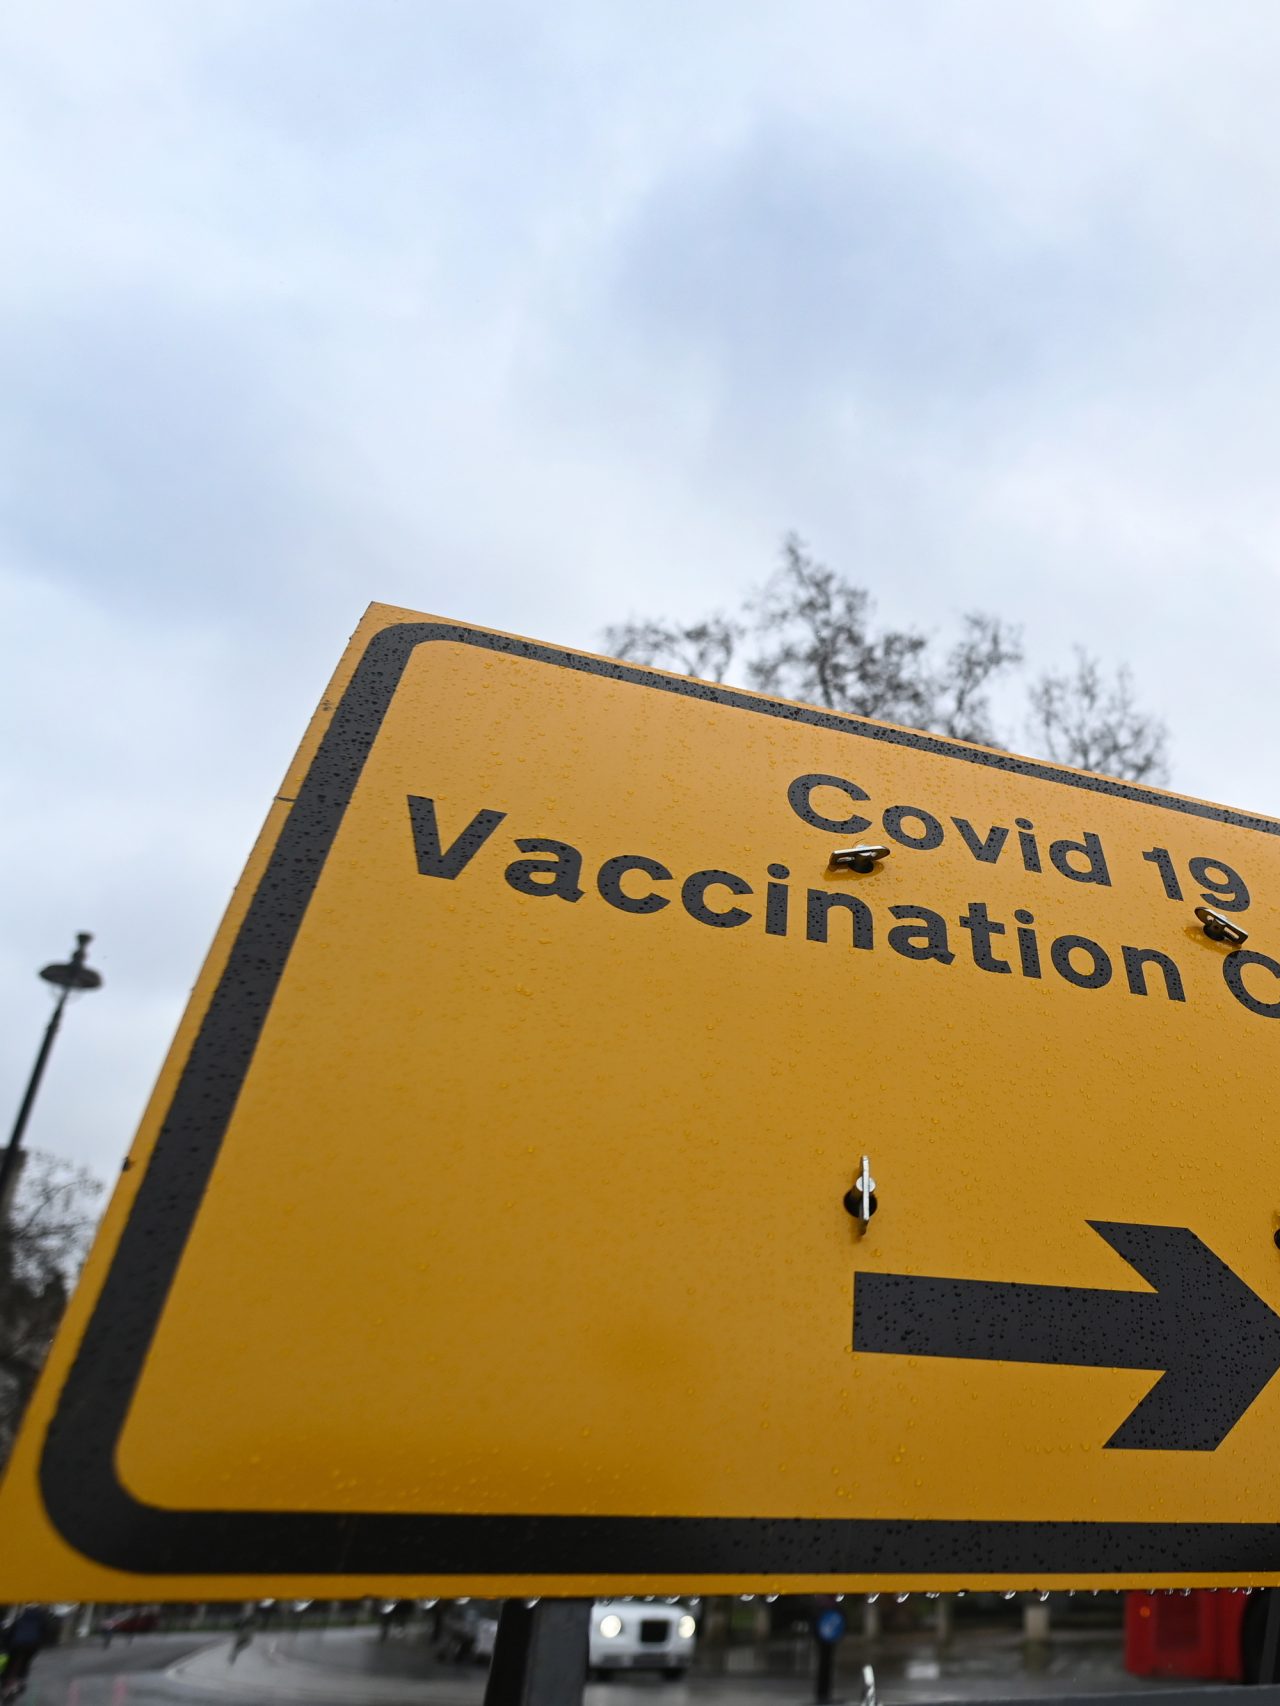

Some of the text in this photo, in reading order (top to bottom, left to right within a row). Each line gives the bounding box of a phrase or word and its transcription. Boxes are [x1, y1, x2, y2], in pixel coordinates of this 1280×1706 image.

[406, 794, 1187, 1003] Vaccination
[787, 773, 1251, 913] Covid 19
